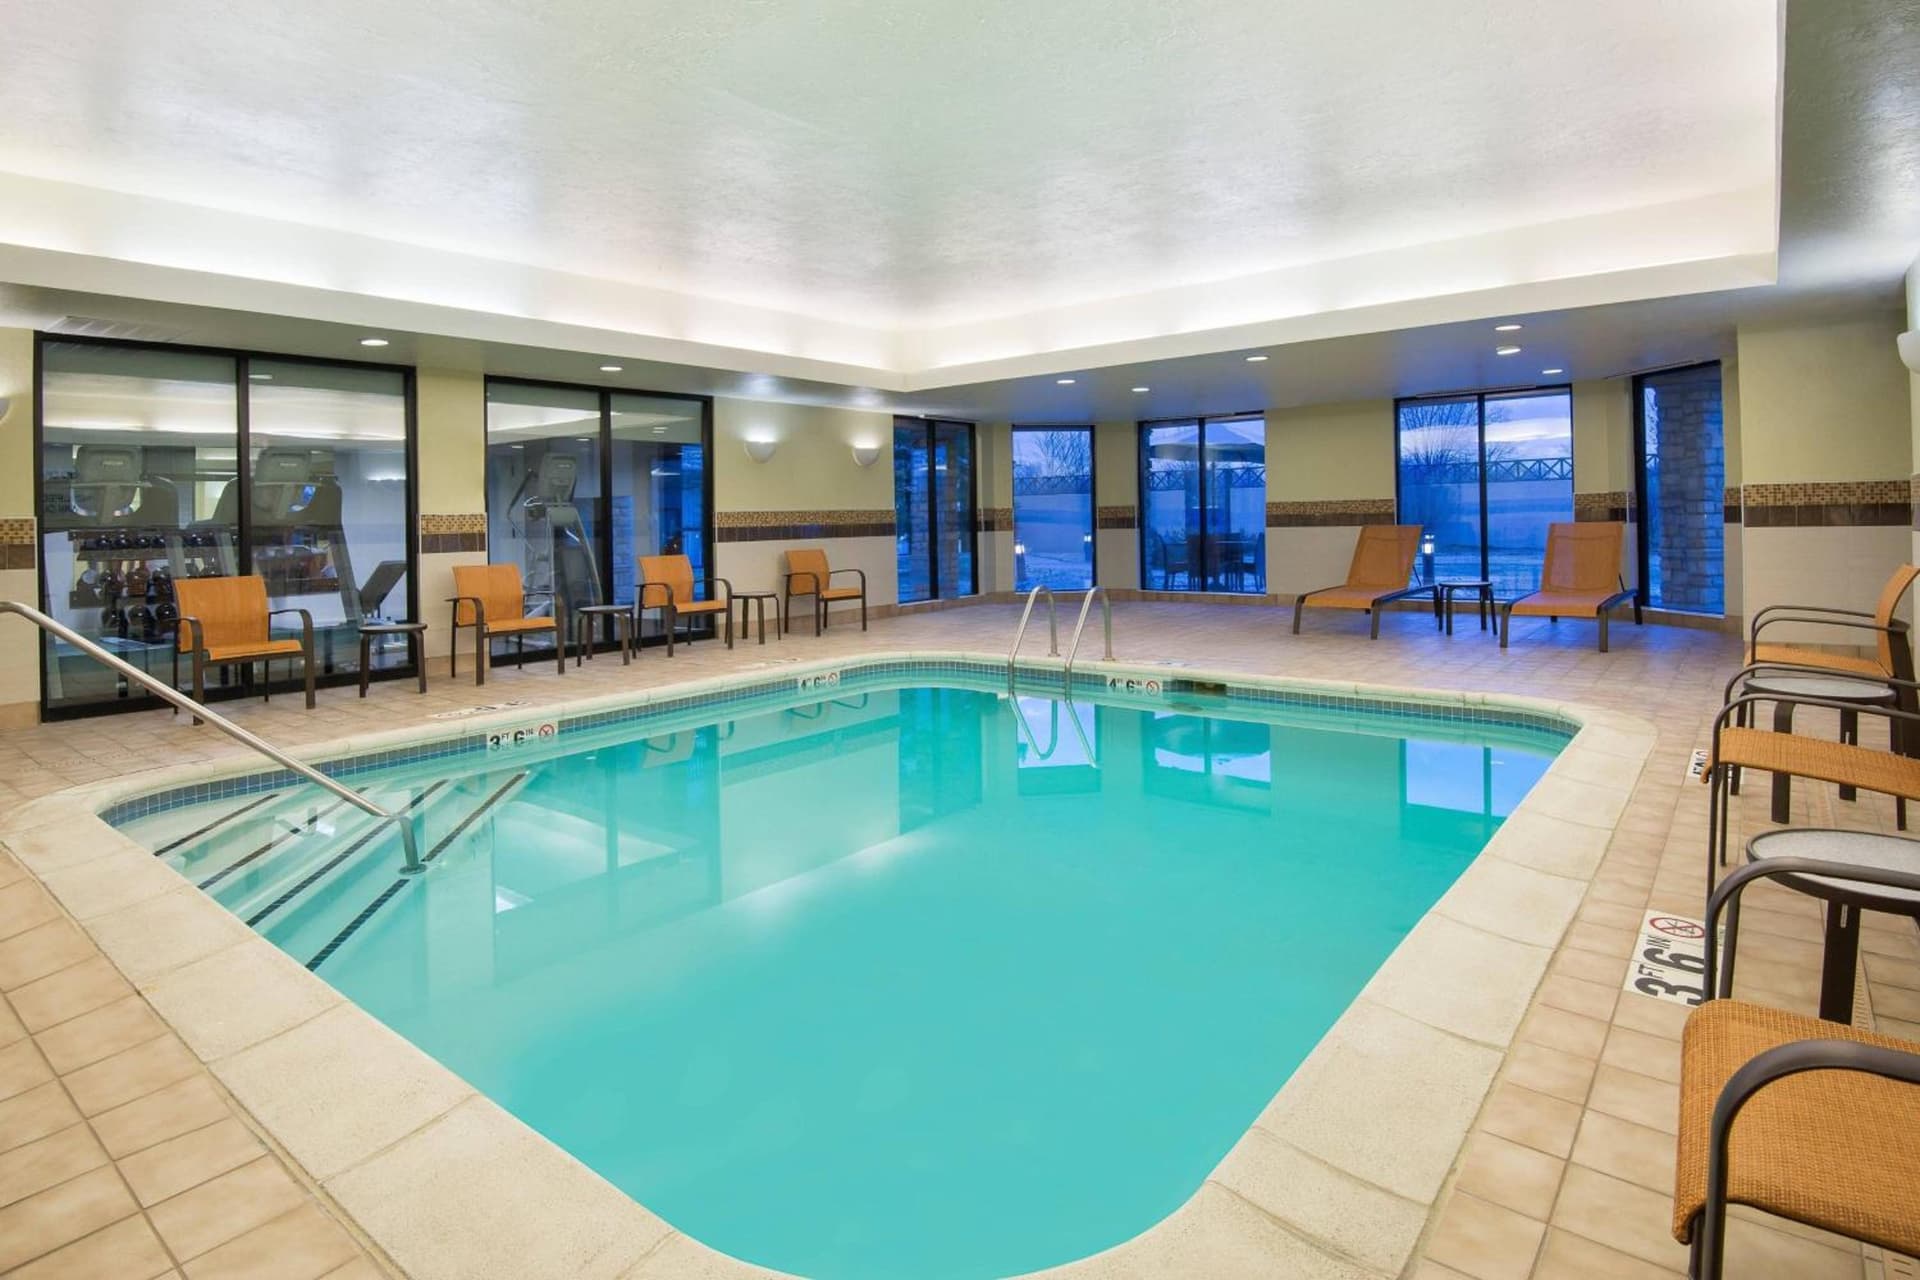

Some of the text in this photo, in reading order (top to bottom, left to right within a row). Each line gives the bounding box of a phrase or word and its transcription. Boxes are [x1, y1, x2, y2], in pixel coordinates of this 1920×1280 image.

[1634, 935, 1705, 1006] 3 FT 6 IN
